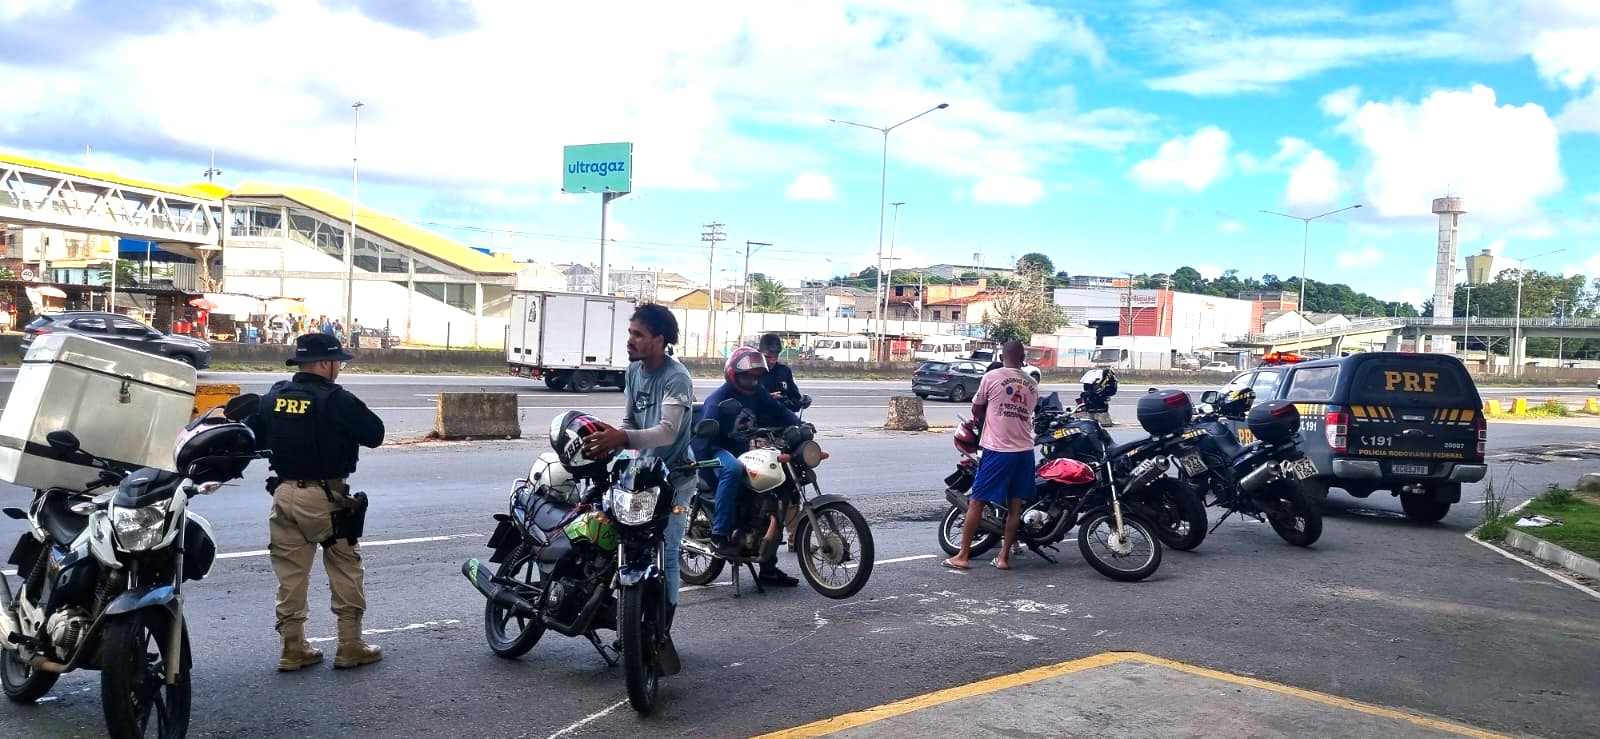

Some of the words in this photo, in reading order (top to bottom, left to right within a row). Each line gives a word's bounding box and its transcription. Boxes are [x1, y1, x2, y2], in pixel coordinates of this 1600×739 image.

[568, 160, 625, 177] ultragaz
[1384, 371, 1439, 392] PRF
[273, 398, 311, 414] PRF
[1306, 421, 1317, 431] 191
[1237, 428, 1257, 444] PR
[1369, 435, 1392, 446] 191
